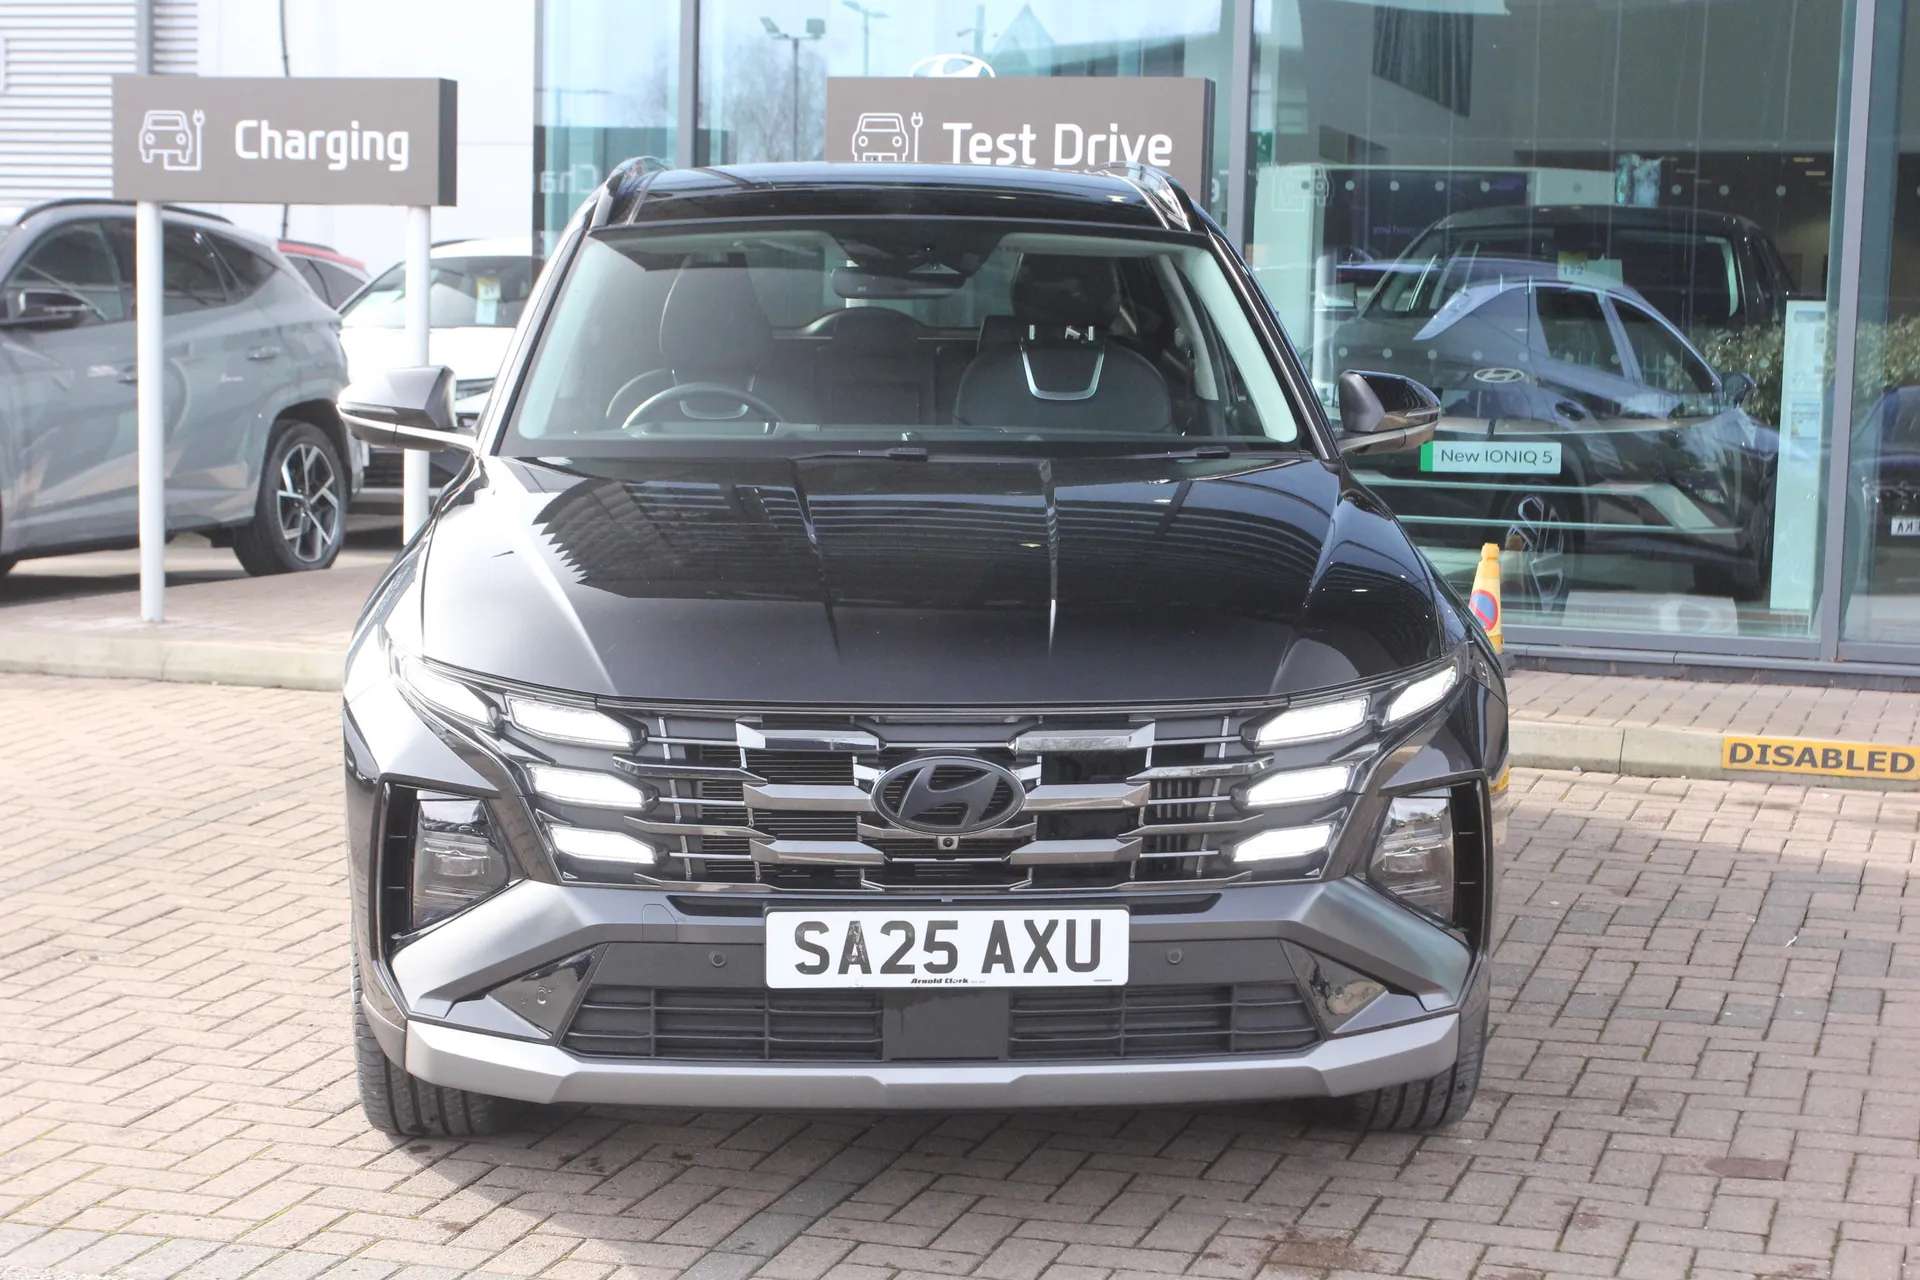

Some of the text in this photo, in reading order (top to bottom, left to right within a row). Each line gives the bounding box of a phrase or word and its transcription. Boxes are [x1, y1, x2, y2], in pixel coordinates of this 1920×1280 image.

[235, 119, 409, 171] Charging
[942, 122, 1173, 167] Test Drive
[1441, 448, 1553, 466] New IONIQ 5
[1728, 742, 1916, 774] DISABLED
[794, 918, 1101, 975] SA25 AXU
[911, 977, 943, 985] Arnold
